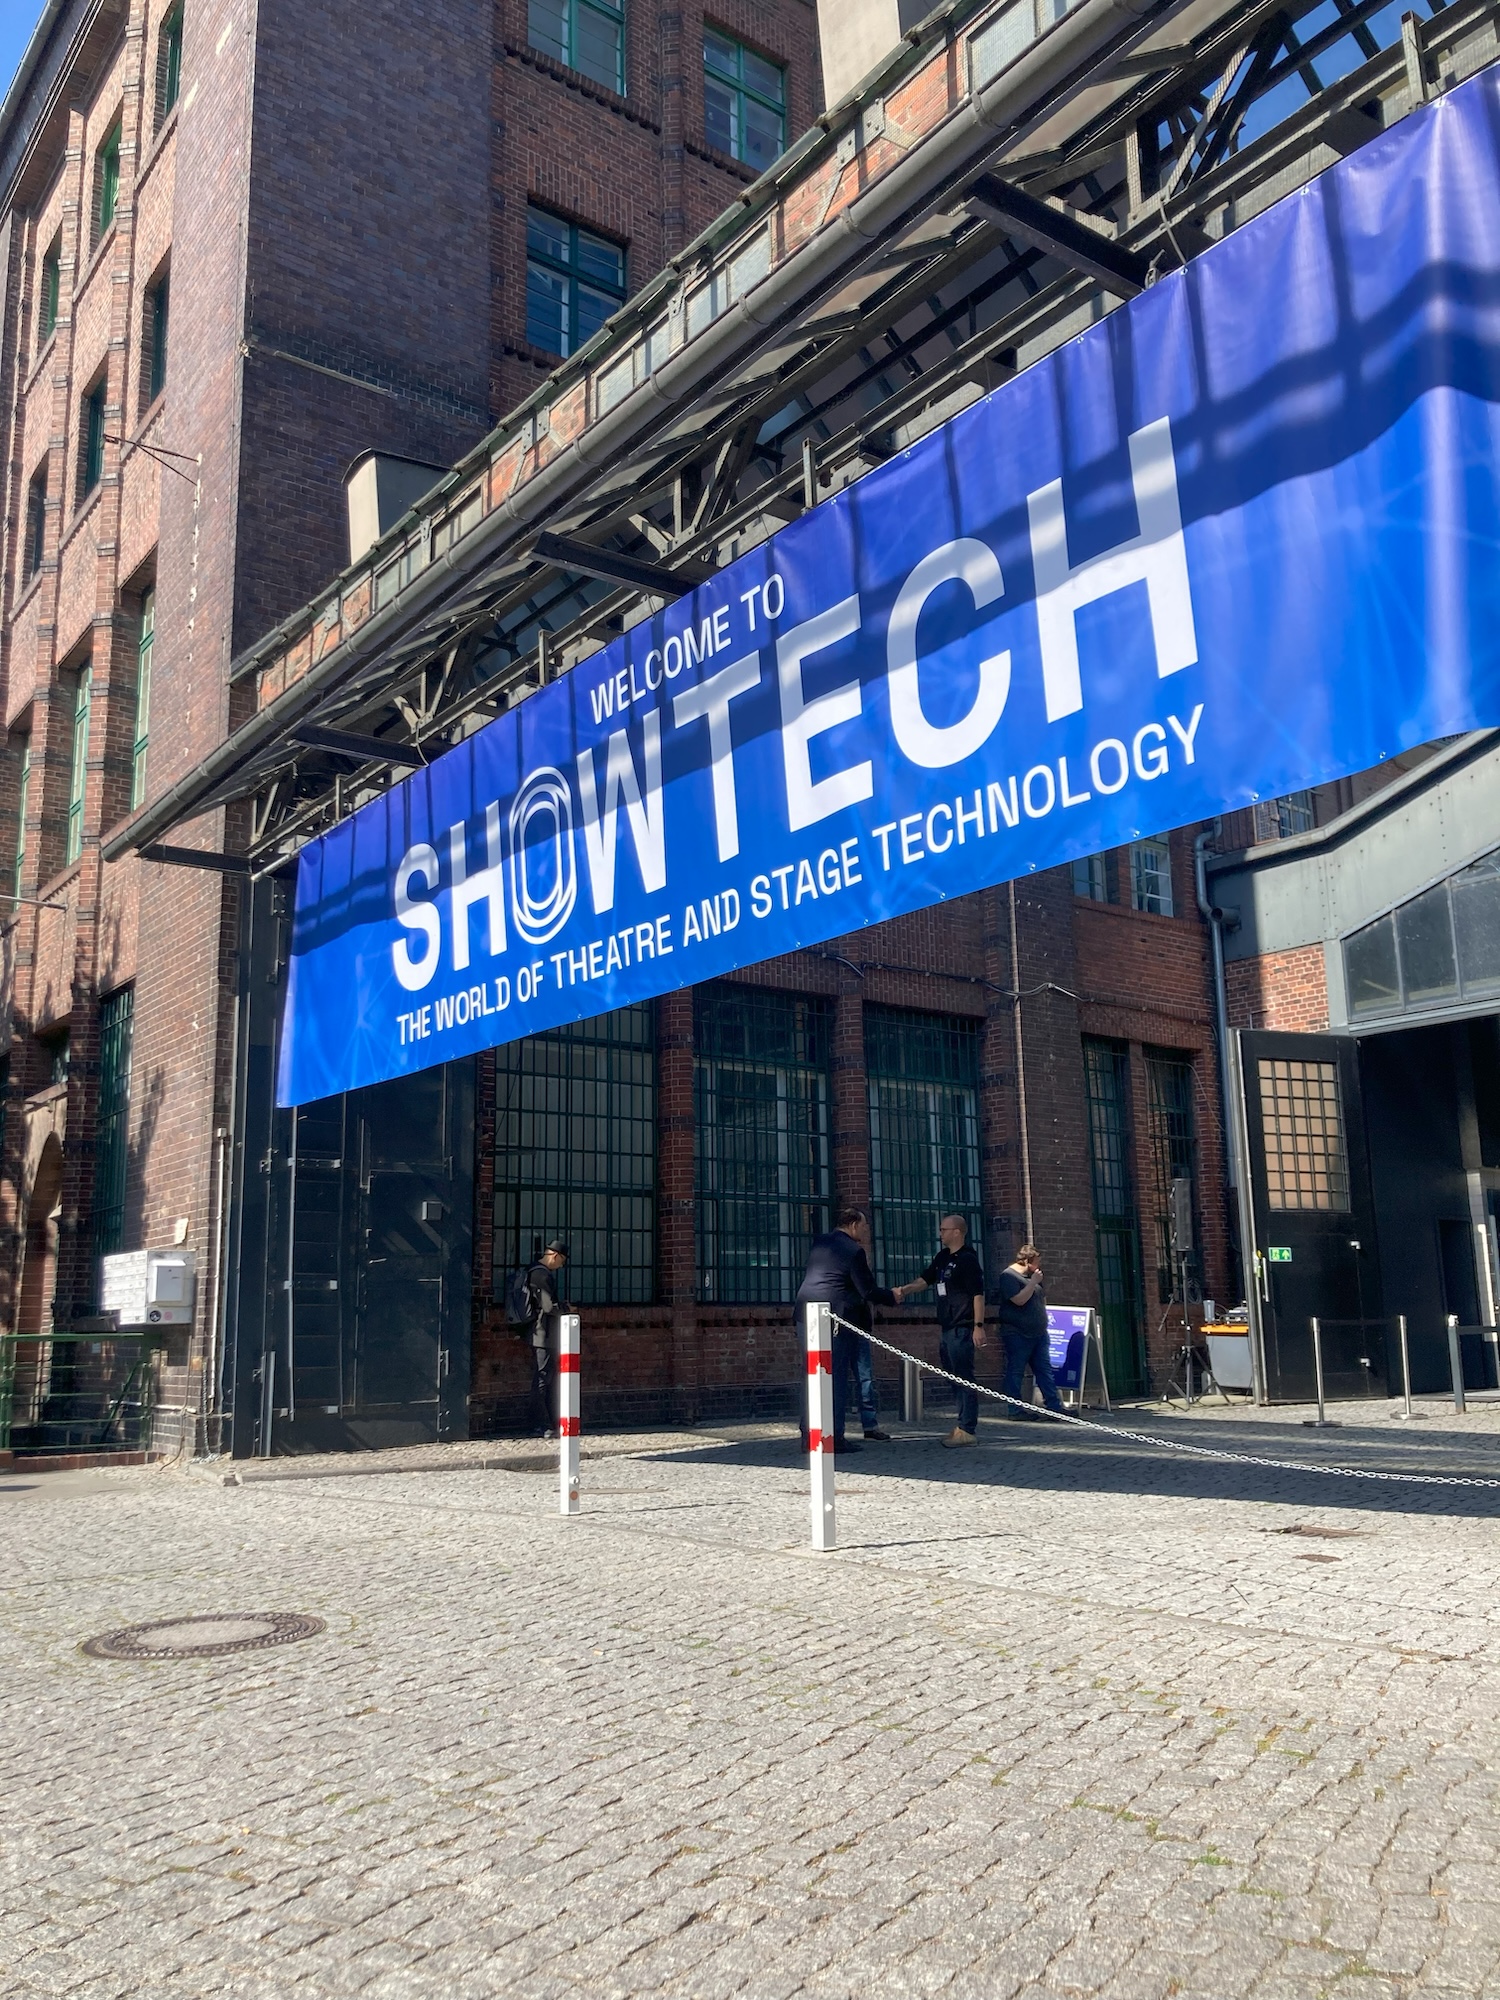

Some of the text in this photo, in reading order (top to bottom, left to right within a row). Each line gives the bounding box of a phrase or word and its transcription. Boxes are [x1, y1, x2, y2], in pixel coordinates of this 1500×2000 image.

[389, 414, 1200, 992] SHOWTECH
[590, 573, 785, 725] WELCOME TO
[397, 703, 1205, 1046] THE WORLD OF THEATRE AND STAGE TECHNOLOGY
